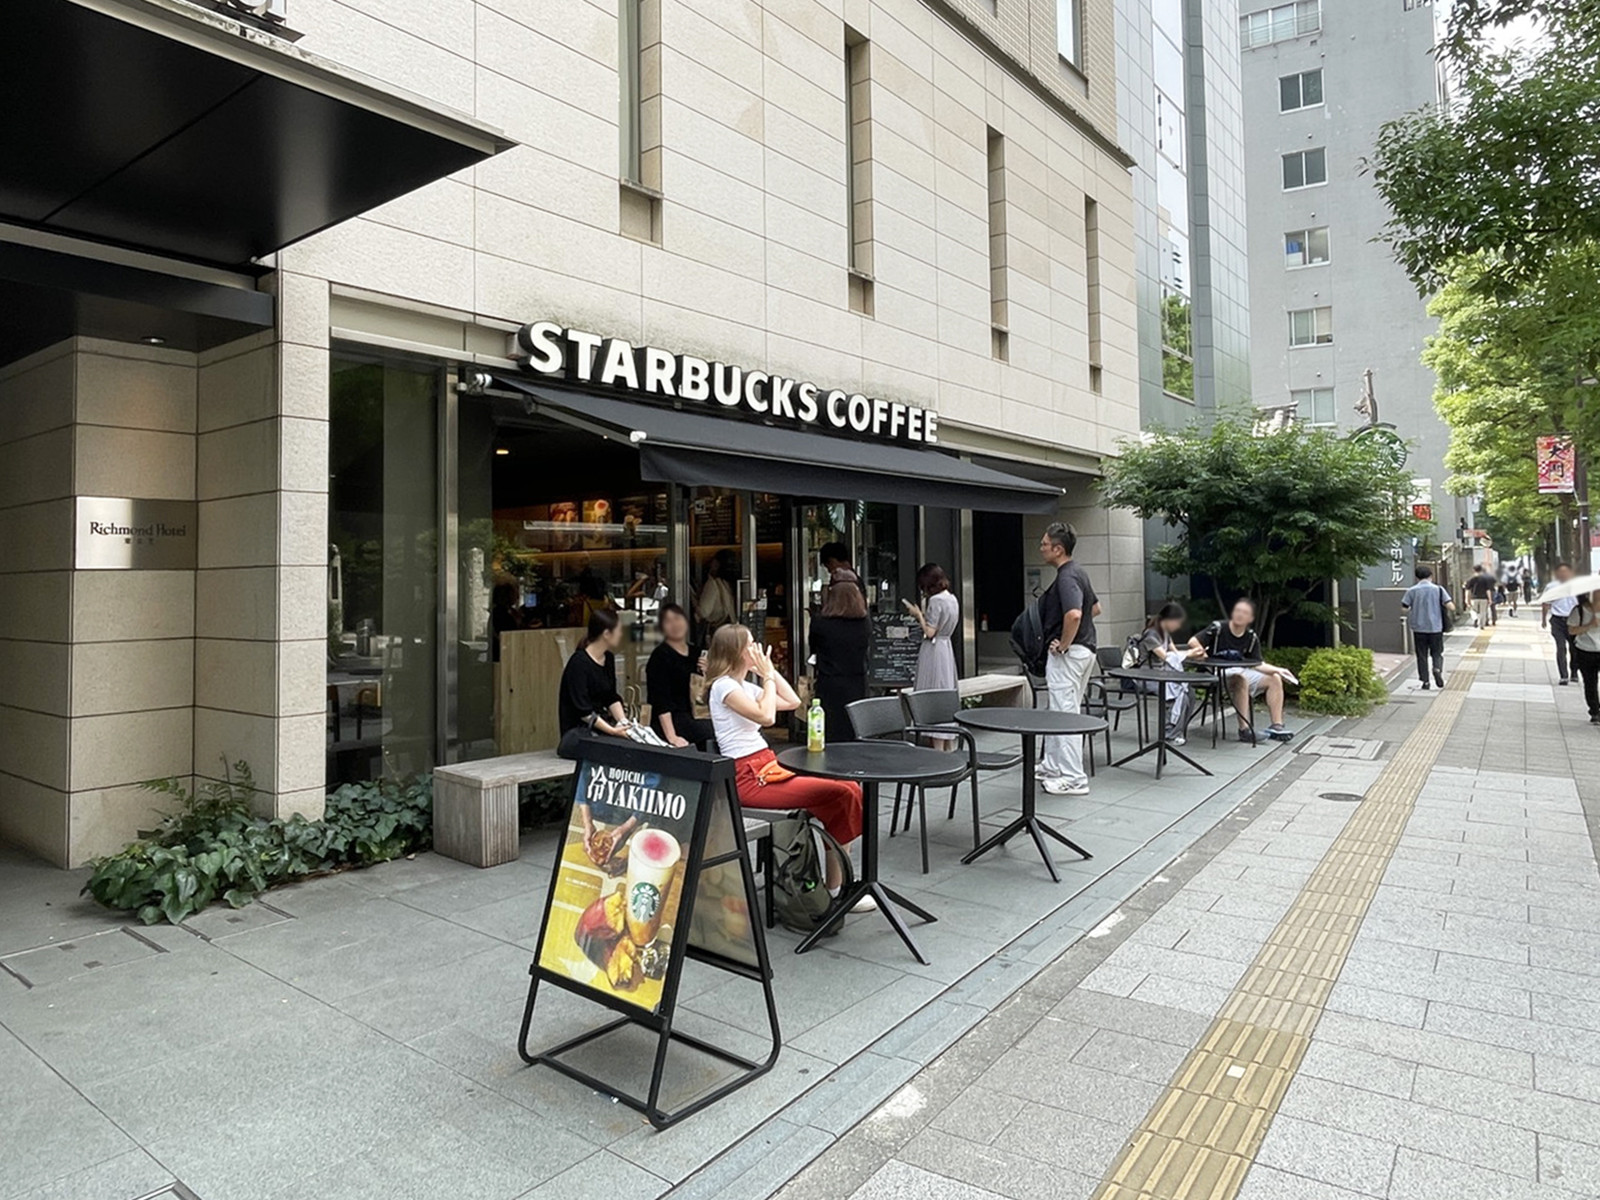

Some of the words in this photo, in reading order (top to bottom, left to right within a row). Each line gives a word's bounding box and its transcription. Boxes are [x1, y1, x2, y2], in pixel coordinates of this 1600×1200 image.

[527, 320, 819, 423] STARBUCKS
[825, 388, 939, 444] COFFEE
[89, 521, 153, 536] Richmond
[156, 523, 187, 536] Hotel
[608, 767, 646, 785] HOJICHA
[606, 780, 686, 820] YAKIIMO
